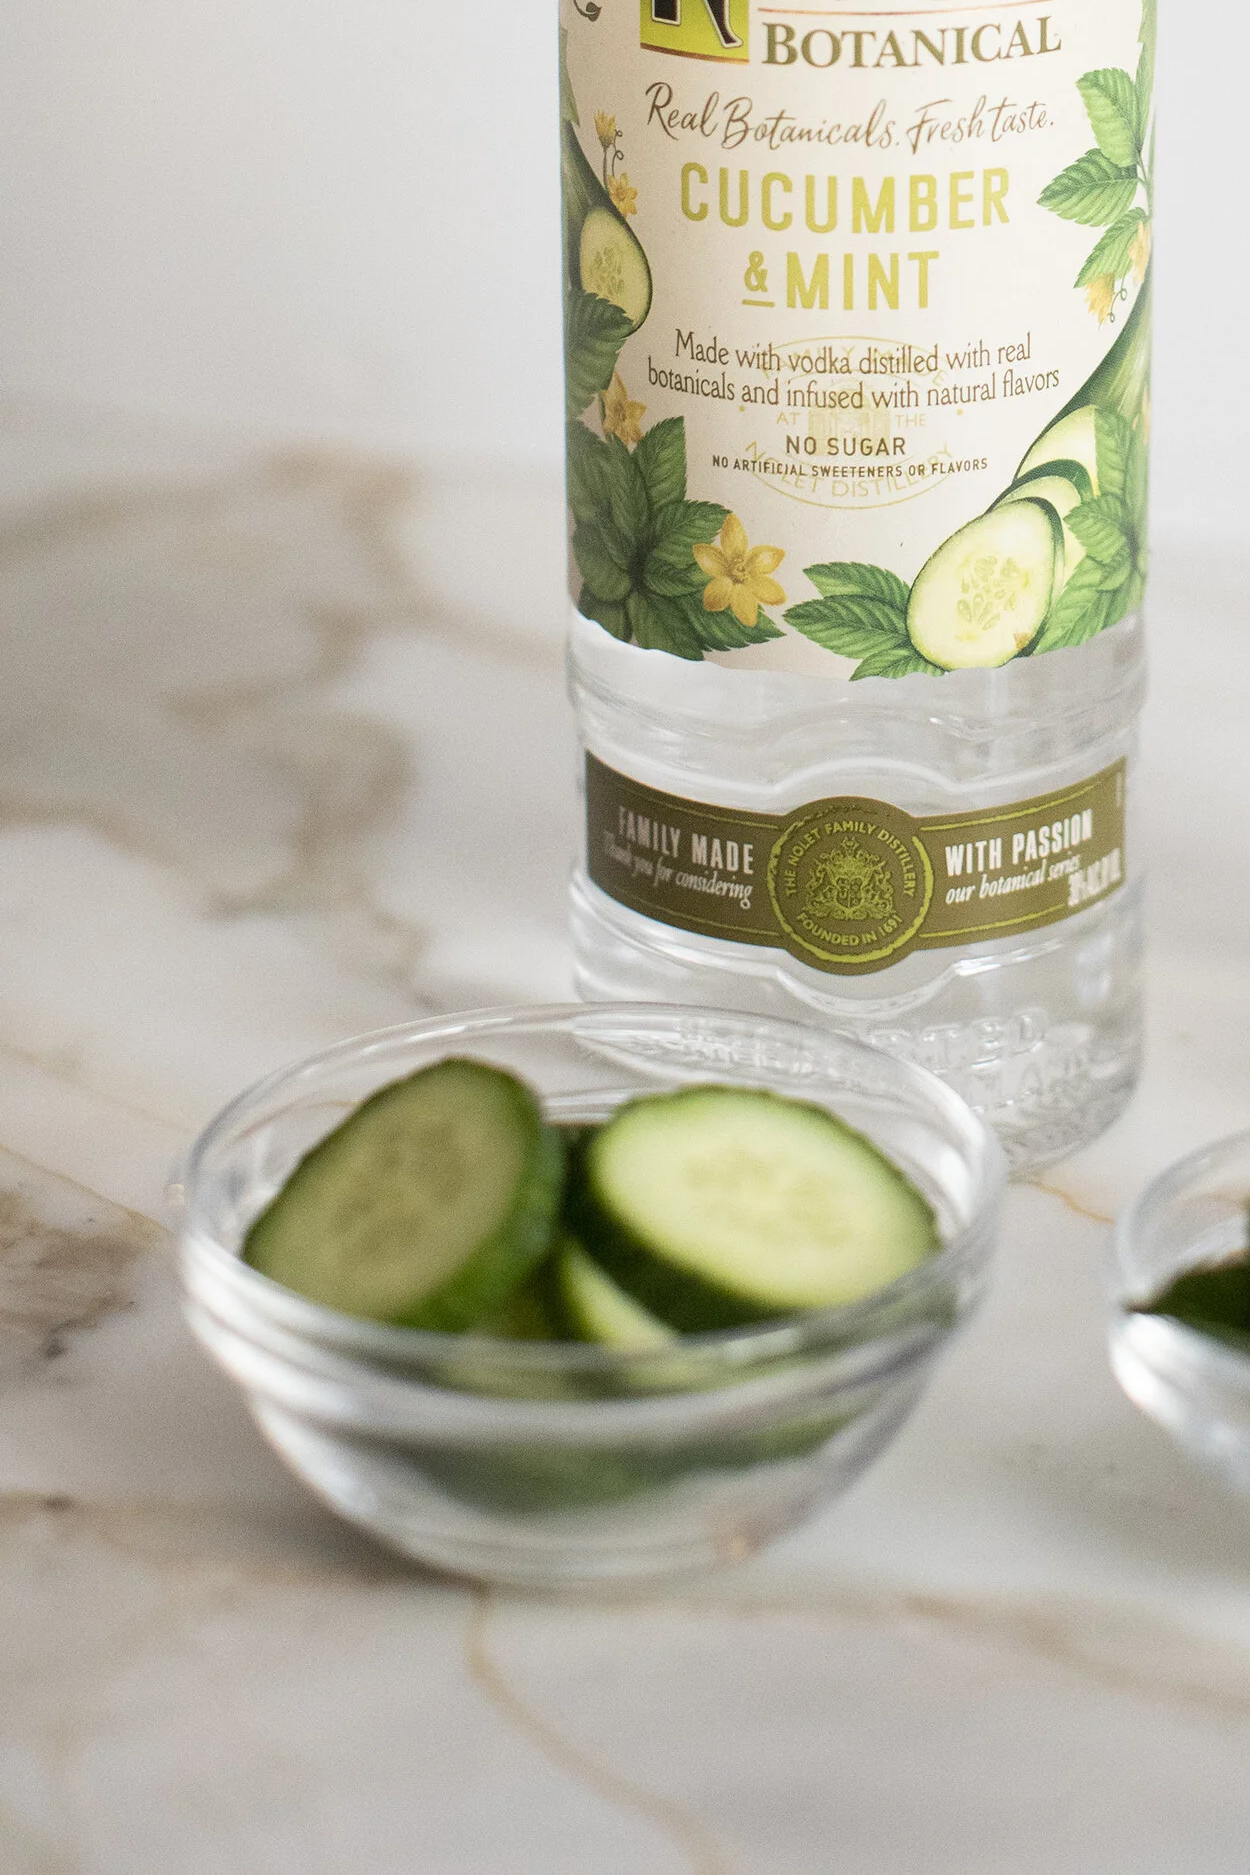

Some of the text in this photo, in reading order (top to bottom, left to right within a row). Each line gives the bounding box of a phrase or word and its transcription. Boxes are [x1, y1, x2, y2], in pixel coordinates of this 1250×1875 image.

[761, 16, 1062, 69] BOTANICAL
[645, 81, 1055, 155] Real Botanicals. Fresh taste.
[679, 161, 1011, 235] CUCUMBER
[675, 328, 1031, 374] Made with vodka distilled with real
[648, 356, 1060, 409] botanicals and infused with natural flavors
[776, 412, 928, 428] AT THE
[786, 435, 907, 457] NO SUGAR
[712, 454, 988, 478] NO ARTIFICIAL SWEETENERS OR FLAVORS
[618, 805, 754, 875] FAMILY MADE
[784, 820, 916, 897] THE NOLET FAMILY DISTILLERY
[945, 808, 1093, 876] WITH PASSION
[653, 856, 753, 910] for considering
[945, 884, 976, 905] our
[979, 858, 1047, 899] botanical
[796, 913, 903, 946] FOUNDED IN 1691
